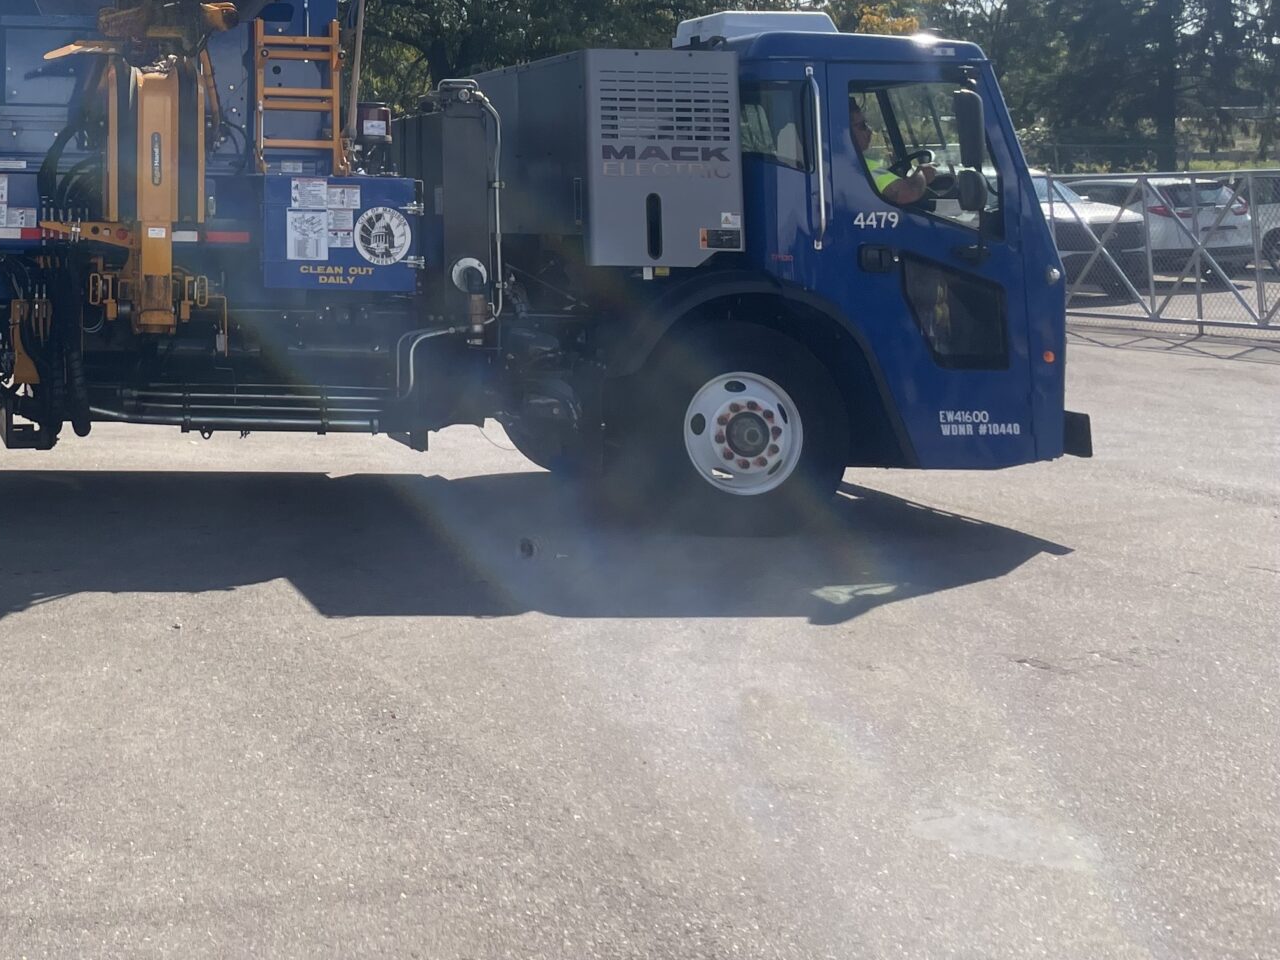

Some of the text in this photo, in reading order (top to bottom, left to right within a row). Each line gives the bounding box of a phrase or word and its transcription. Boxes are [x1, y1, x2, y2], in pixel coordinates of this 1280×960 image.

[601, 144, 731, 162] MACK
[602, 161, 732, 179] ELECTRIC
[382, 207, 408, 226] MADISON
[853, 211, 899, 229] 4479
[299, 265, 375, 275] CLEAN OUT
[318, 275, 356, 284] DAILY
[939, 410, 990, 423] EW41600
[940, 423, 1021, 436] WDNR #10440
